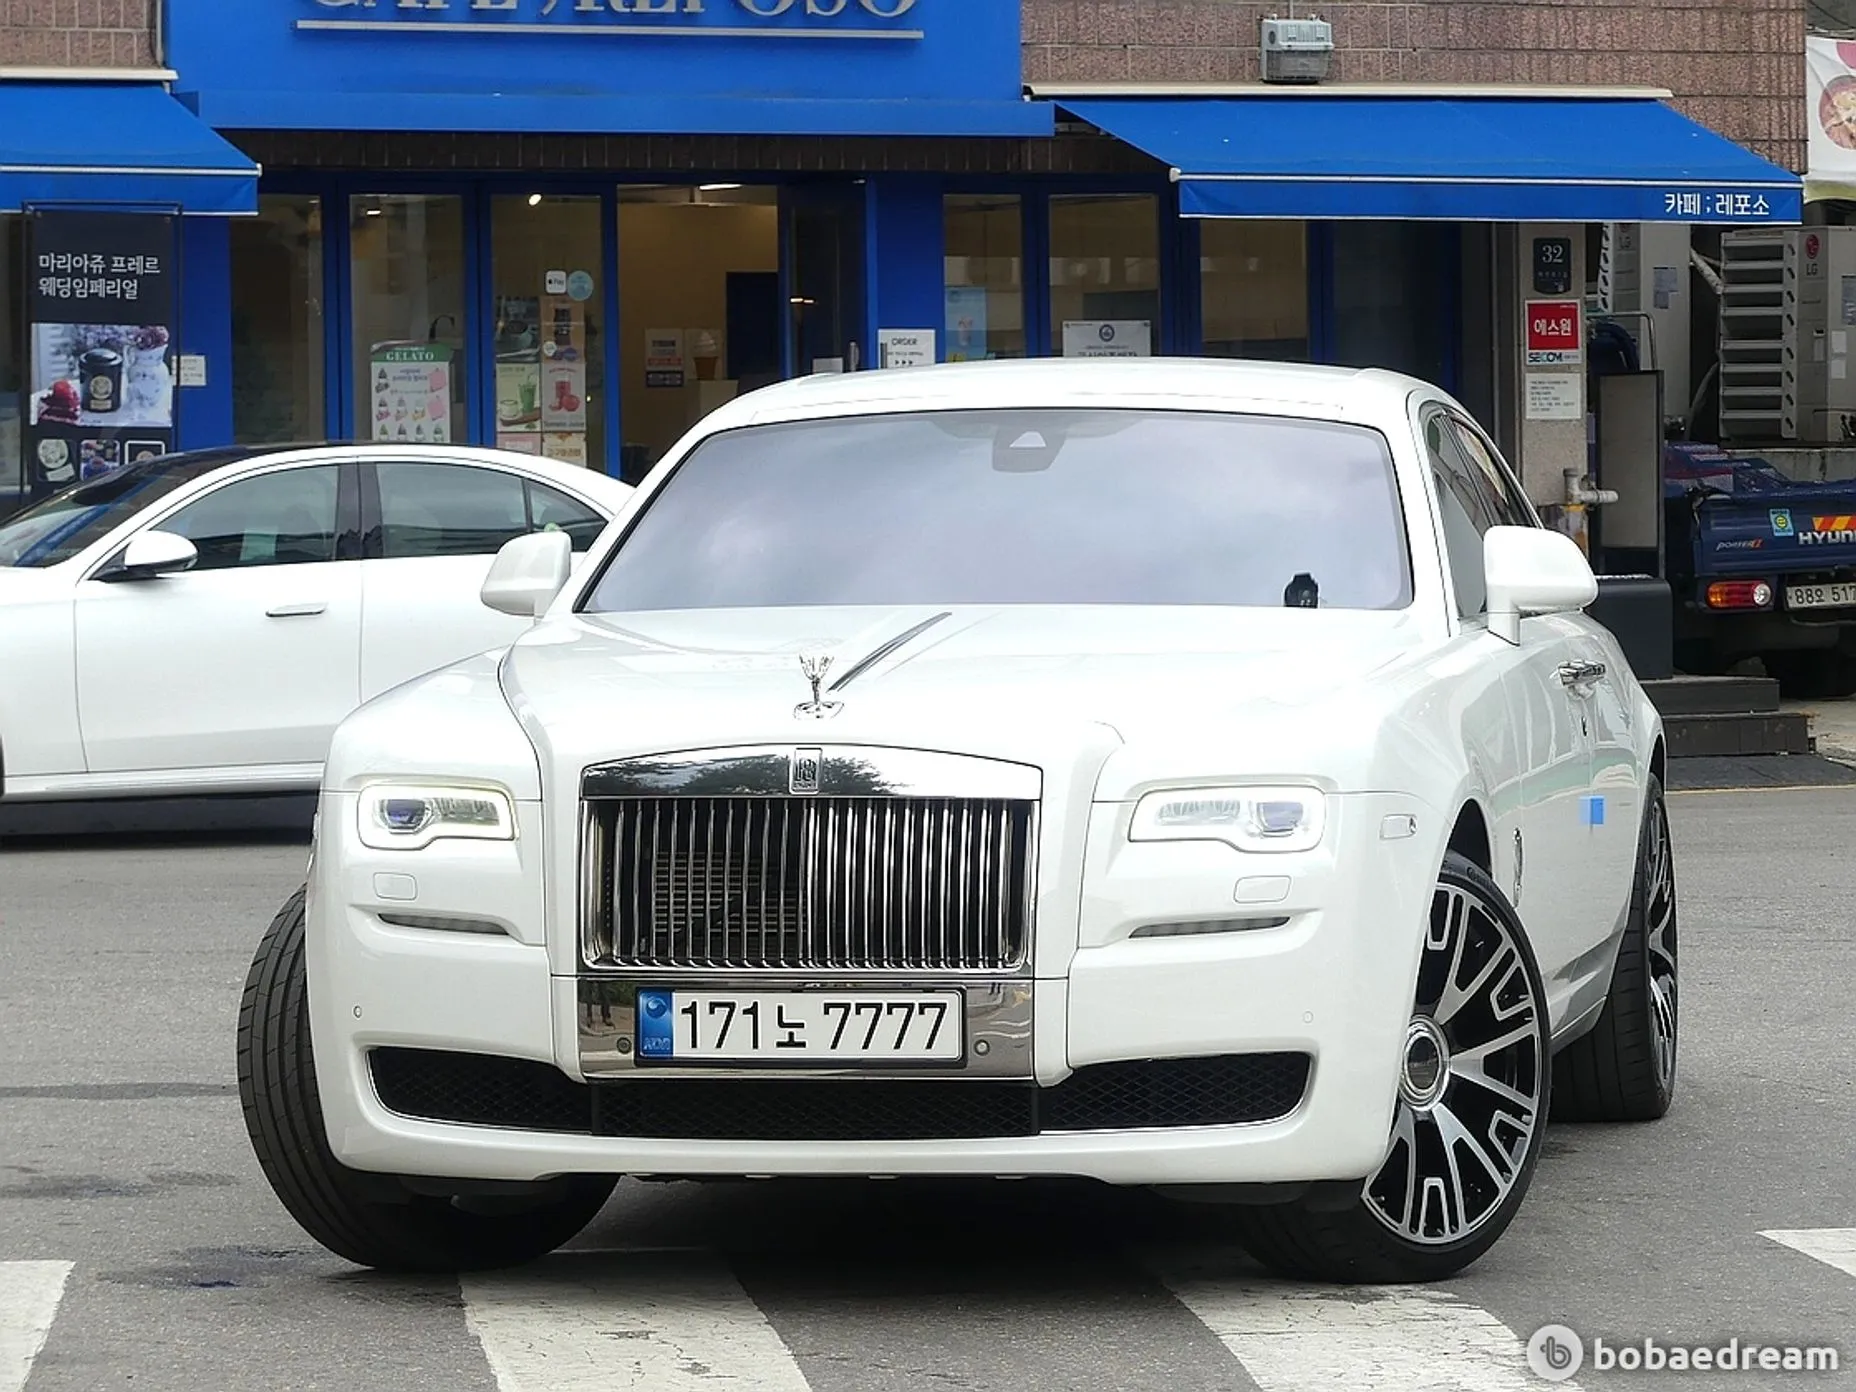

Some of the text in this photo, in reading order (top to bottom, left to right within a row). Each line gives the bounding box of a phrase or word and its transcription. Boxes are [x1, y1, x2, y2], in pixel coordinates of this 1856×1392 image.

[1664, 192, 1700, 216] 카페
[1715, 193, 1770, 216] 레포소
[1541, 244, 1563, 263] 32
[38, 253, 161, 275] 마리아쥬 프레르
[1806, 262, 1818, 276] LG
[38, 277, 139, 300] 웨딩임페리얼
[1534, 318, 1572, 336] 에스원
[891, 337, 917, 346] ORDER
[386, 351, 434, 361] GELATO
[1528, 351, 1563, 363] SECOM
[1798, 530, 1856, 545] HYUN
[680, 1000, 948, 1050] 171노 7777
